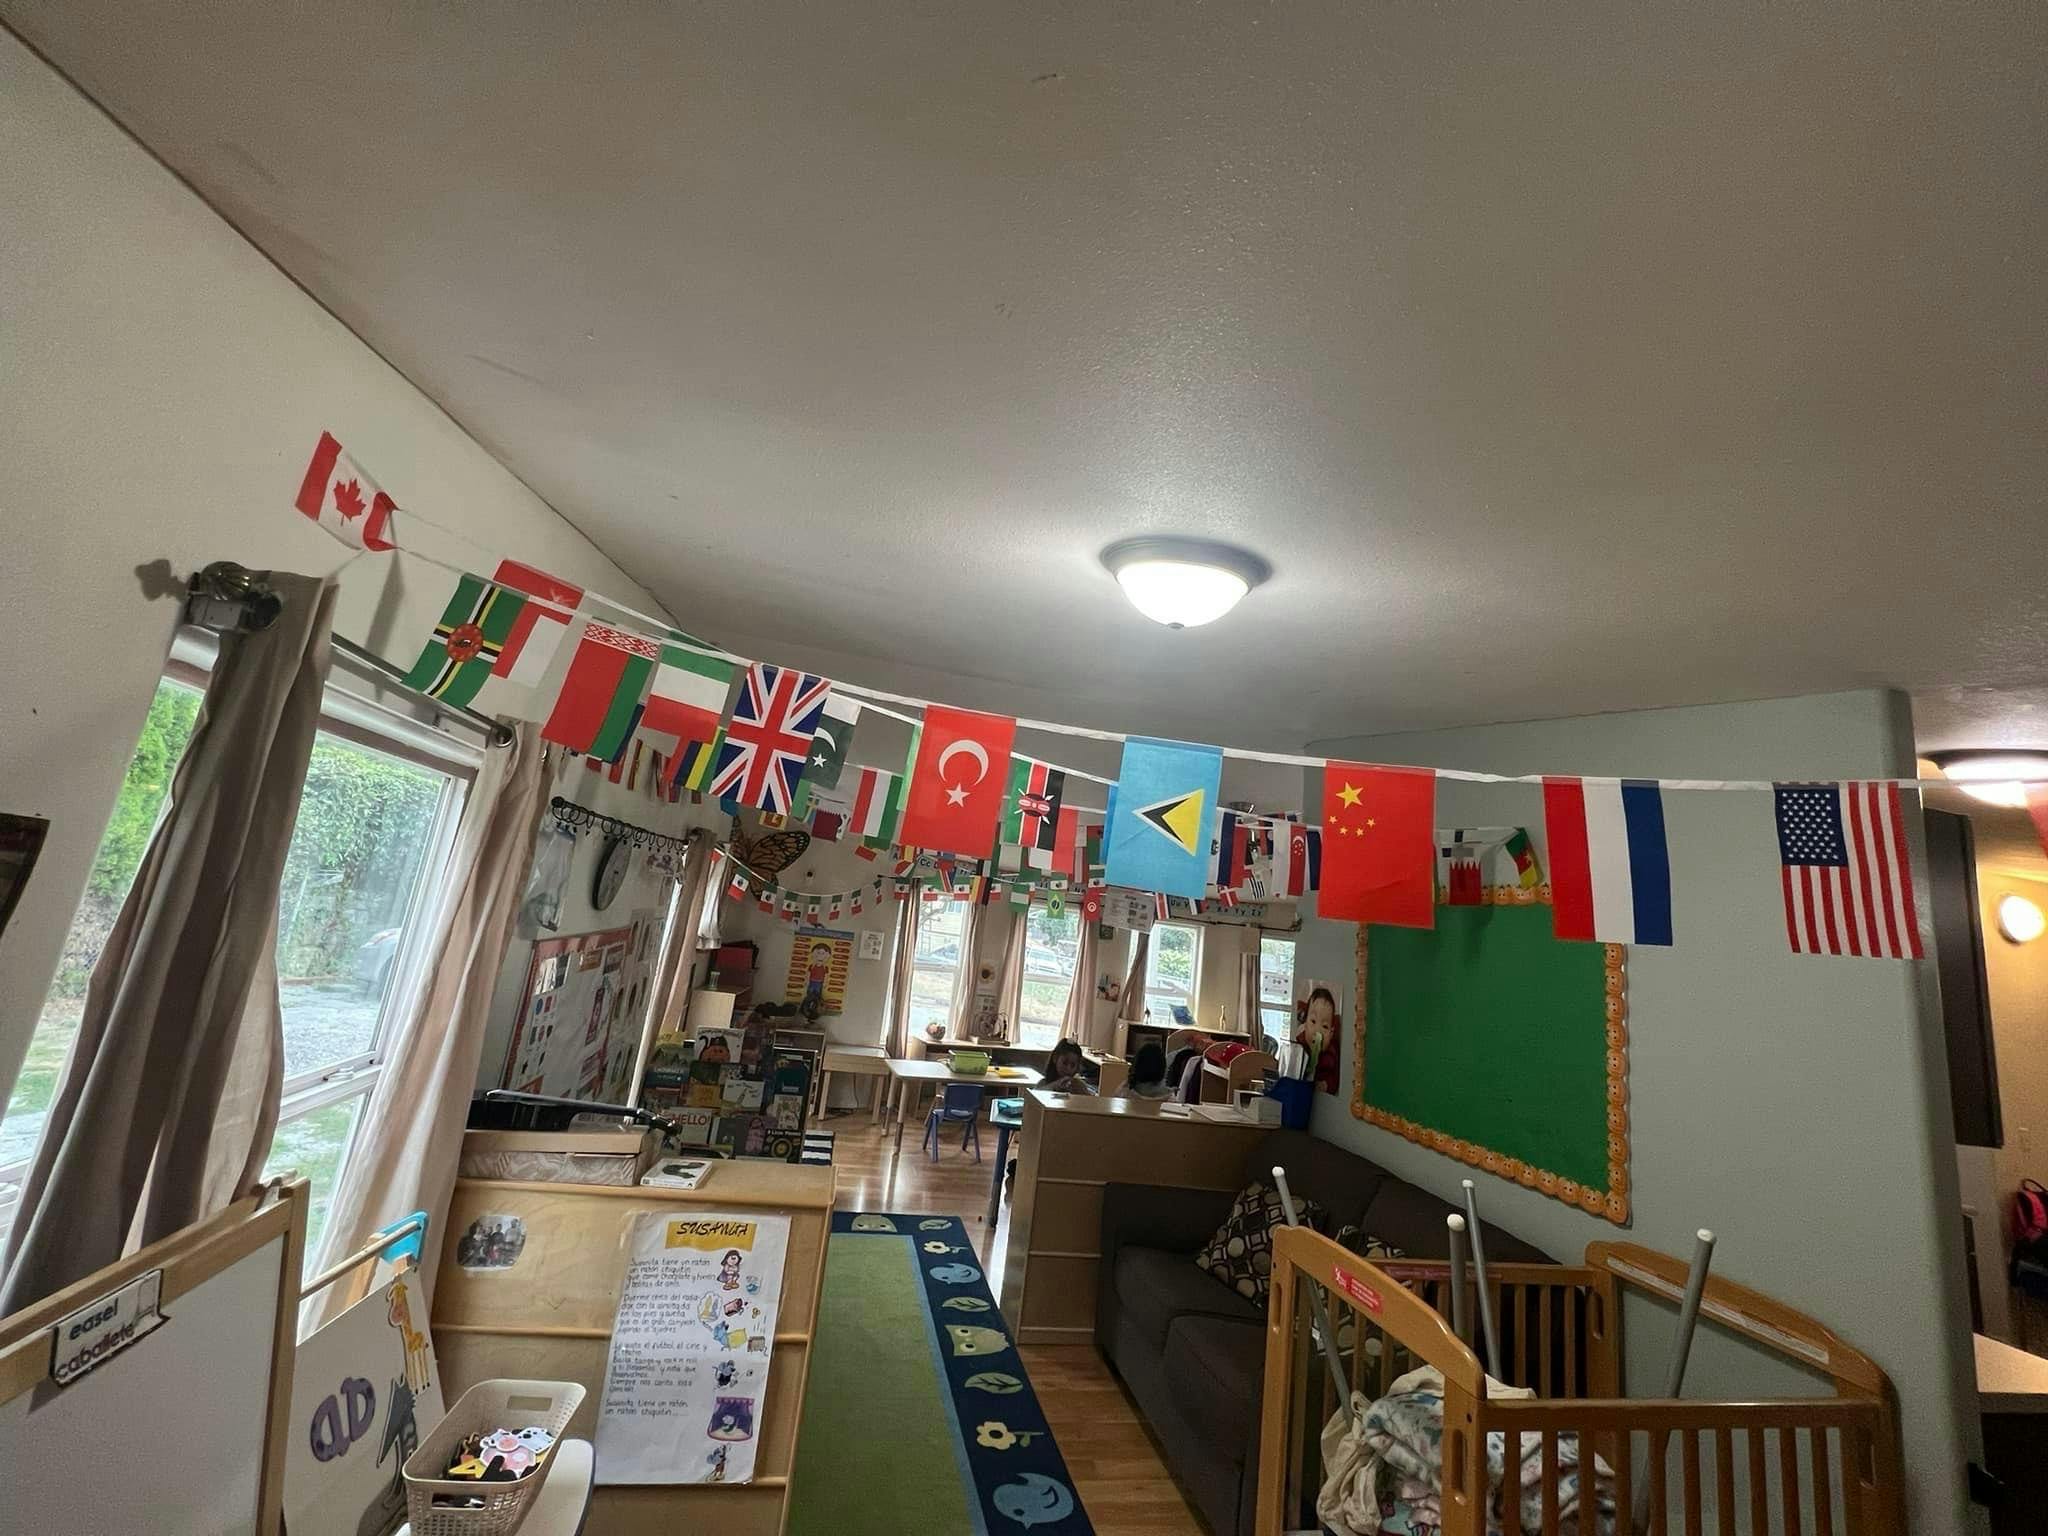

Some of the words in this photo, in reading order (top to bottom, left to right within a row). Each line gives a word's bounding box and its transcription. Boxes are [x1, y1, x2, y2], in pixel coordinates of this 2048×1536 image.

[920, 858, 931, 867] Cc
[69, 1297, 119, 1340] easel
[56, 1323, 135, 1378] caballete
